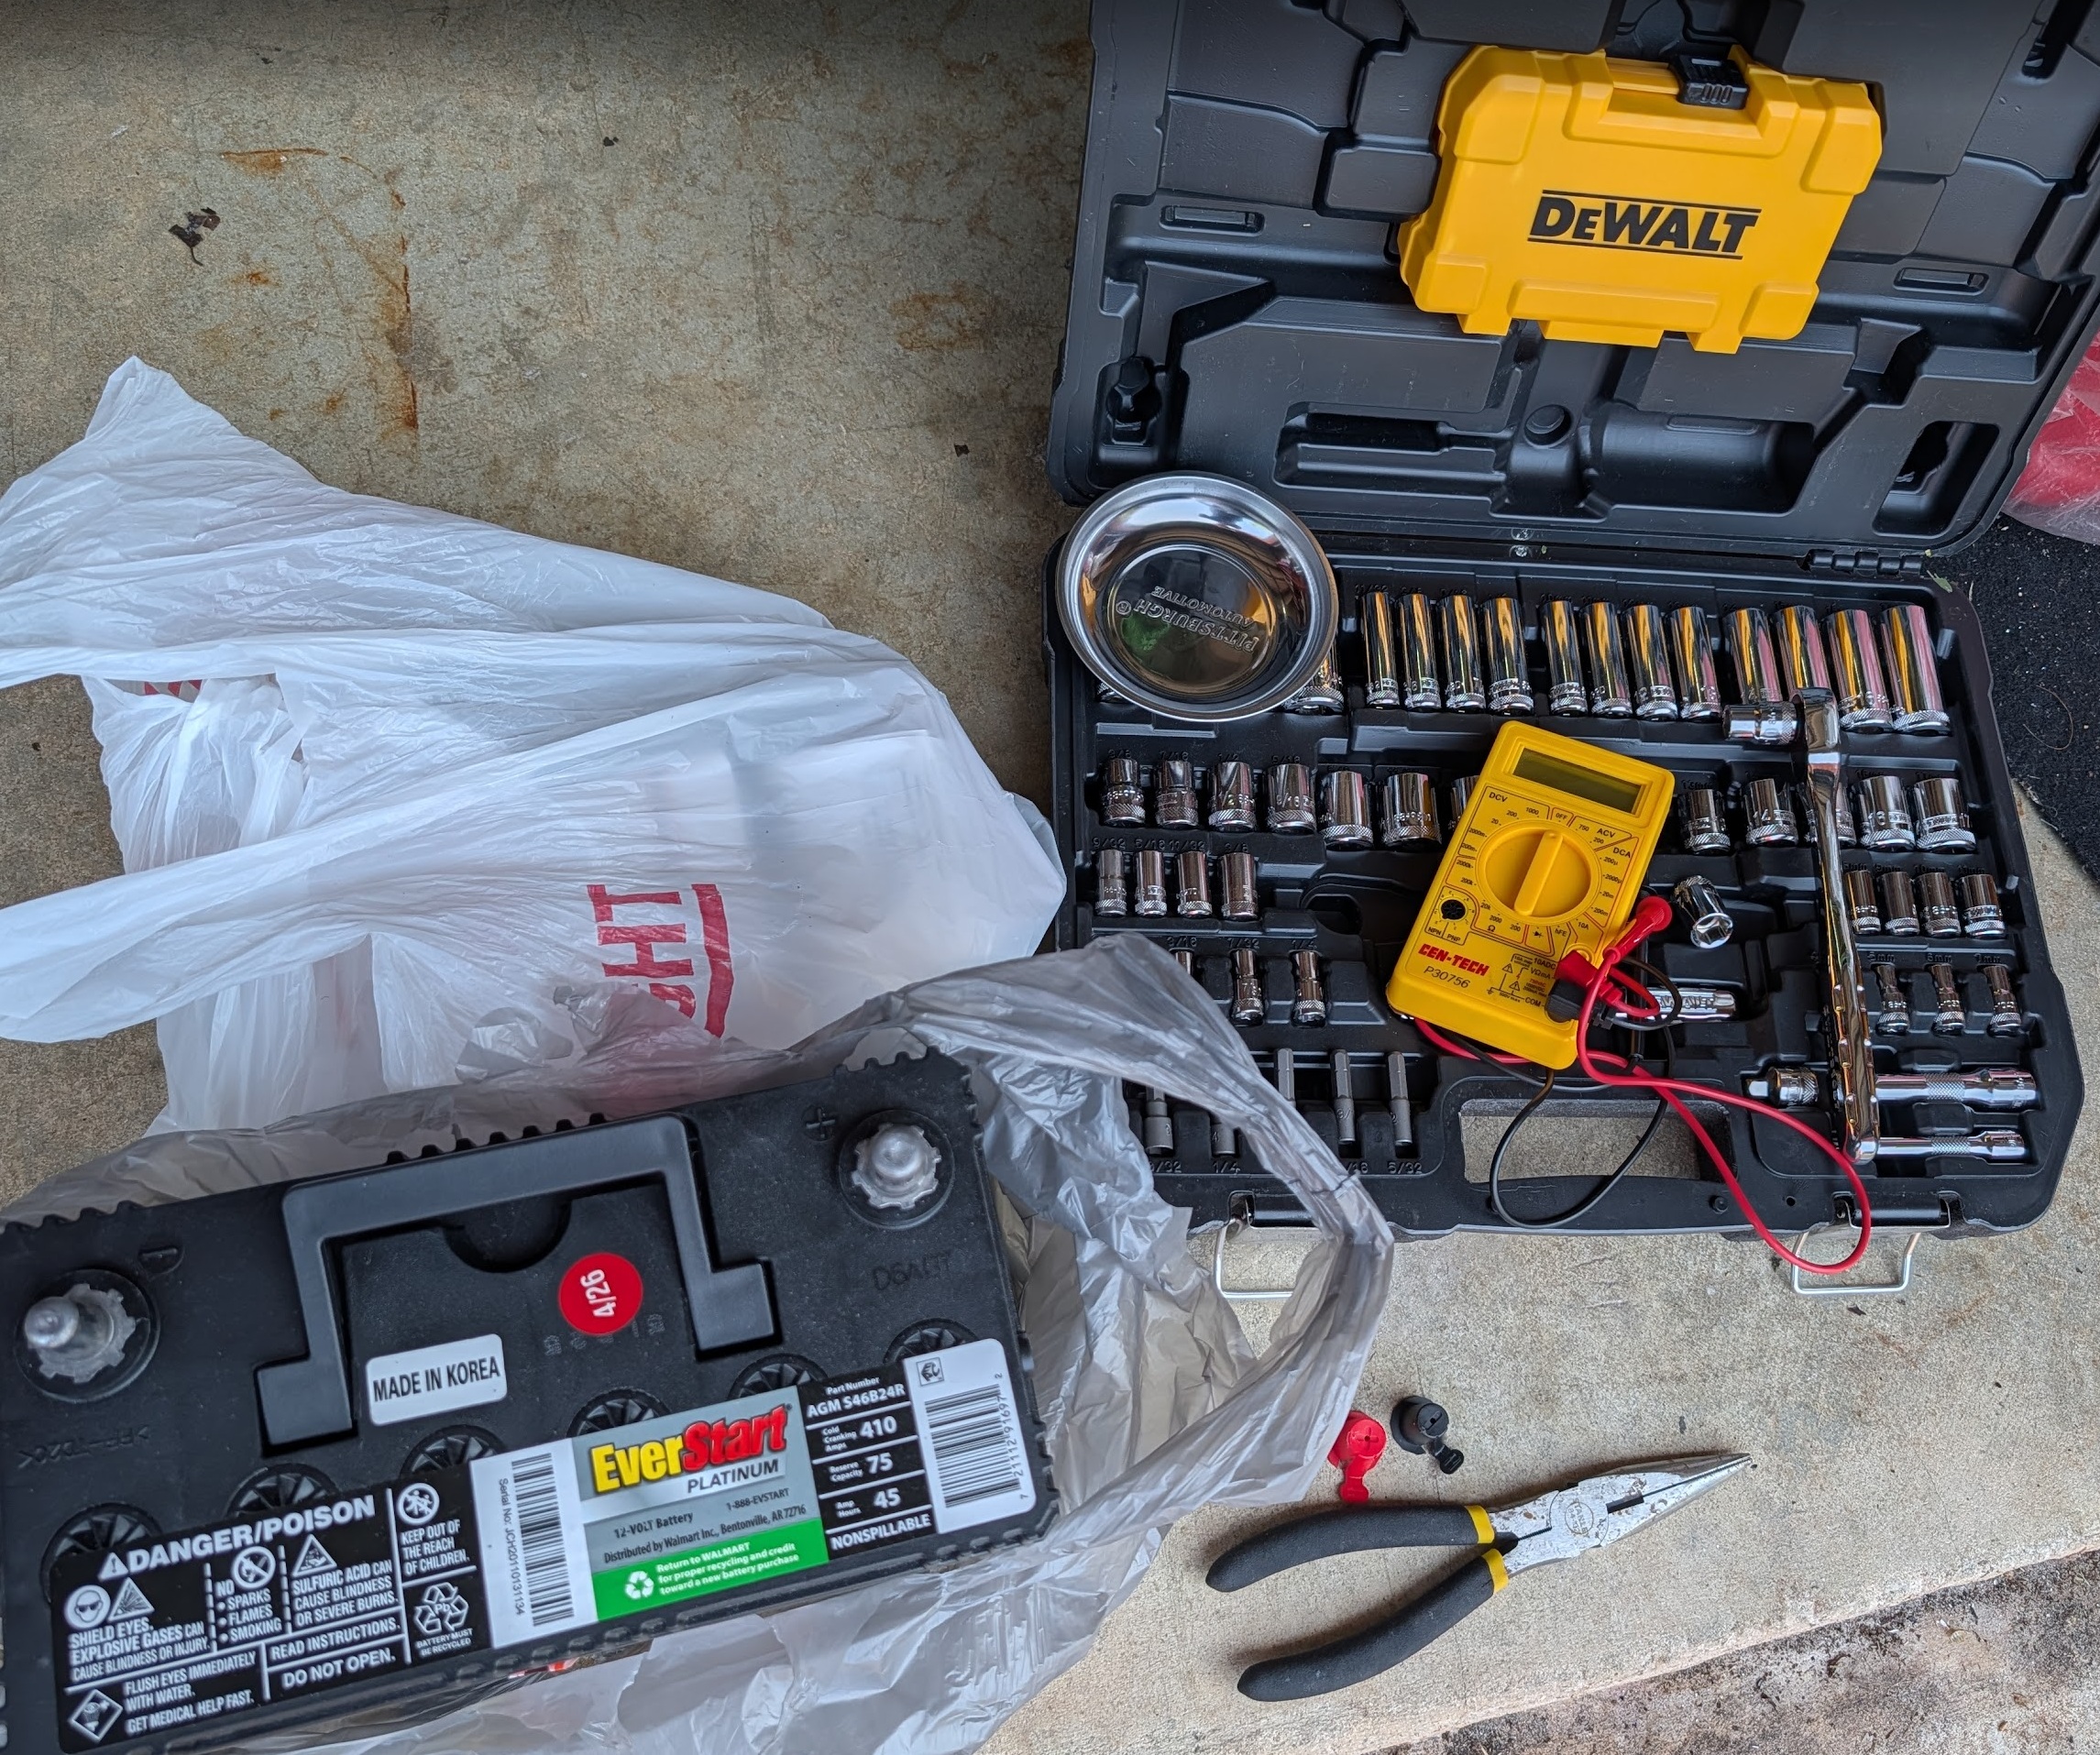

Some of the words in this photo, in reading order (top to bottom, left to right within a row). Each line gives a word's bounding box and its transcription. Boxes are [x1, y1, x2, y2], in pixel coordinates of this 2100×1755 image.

[1150, 585, 1255, 631] AUTOMOTIVE
[1133, 598, 1260, 654] PITTSBURGH
[1489, 792, 1508, 803] DCV
[1556, 812, 1567, 820] OFF
[1597, 828, 1616, 839] ACV
[1612, 847, 1632, 859] DCA
[1418, 943, 1490, 977] CEN-TECH
[1534, 958, 1556, 971] 10ADC
[1424, 965, 1471, 989] P30756
[1525, 997, 1542, 1007] COM
[580, 1269, 617, 1317] 4/26
[373, 1371, 422, 1402] MADE
[425, 1367, 443, 1391] IN
[446, 1356, 501, 1388] KOREA
[826, 1383, 845, 1396] Part
[846, 1377, 880, 1391] Number
[807, 1399, 842, 1419] AGM
[843, 1384, 906, 1409] S46B24R
[822, 1425, 840, 1436] Cold
[823, 1431, 858, 1445] Cranking
[859, 1416, 898, 1440] 410
[589, 1404, 788, 1494] EverStart
[826, 1442, 848, 1453] Amps
[687, 1458, 779, 1493] PLATINUM
[830, 1461, 860, 1474] Reserve
[830, 1468, 863, 1483] Capacity
[865, 1452, 894, 1475] 75
[499, 1477, 510, 1508] Serial
[726, 1488, 789, 1510] 1-888-EVSTART
[835, 1499, 855, 1511] Amp
[873, 1487, 901, 1509] 45
[837, 1506, 862, 1519] Hours
[127, 1495, 376, 1570] DANGER/POISON
[401, 1528, 425, 1545] KEEP
[427, 1524, 446, 1539] OUT
[448, 1519, 461, 1533] OF
[604, 1542, 652, 1564] Distributed
[653, 1540, 664, 1553] by
[664, 1531, 700, 1550] Walmart
[720, 1514, 771, 1535] Bentonville,
[772, 1509, 784, 1522] AR
[784, 1504, 807, 1519] 72716
[614, 1521, 654, 1540] 12-VOLT
[656, 1512, 694, 1529] Battery
[830, 1512, 932, 1551] NONSPILLABLE
[402, 1544, 423, 1561] THE
[423, 1536, 455, 1556] REACH
[656, 1558, 689, 1574] Return
[690, 1555, 701, 1566] to
[701, 1542, 751, 1563] WALMART
[404, 1561, 418, 1576] OF
[420, 1549, 470, 1573] CHILDREN.
[657, 1574, 673, 1585] for
[674, 1565, 706, 1584] proper
[707, 1555, 749, 1575] recycling
[750, 1550, 768, 1564] and
[768, 1542, 797, 1559] credit
[659, 1580, 694, 1596] toward
[701, 1573, 721, 1585] new
[721, 1562, 756, 1580] battery
[756, 1552, 799, 1573] purchase
[214, 1579, 235, 1597] NO
[291, 1570, 344, 1596] SULFURIC
[346, 1562, 371, 1582] ACID
[374, 1559, 392, 1575] CAN
[228, 1588, 271, 1611] SPARKS
[293, 1590, 330, 1612] CAUSE
[333, 1576, 392, 1601] BLINDNESS
[229, 1604, 273, 1627] FLAMES
[295, 1611, 313, 1627] OR
[315, 1601, 356, 1623] SEVERE
[357, 1590, 400, 1611] BURNS.
[434, 1603, 450, 1616] Pb
[69, 1625, 115, 1650] SHIELD
[116, 1617, 154, 1635] EYES.
[71, 1636, 140, 1666] EXPLOSIVE
[142, 1624, 183, 1649] GASES
[184, 1620, 204, 1639] CAN
[230, 1618, 282, 1643] SMOKING
[271, 1643, 305, 1662] READ
[307, 1617, 401, 1652] INSTRUCTIONS.
[415, 1633, 450, 1649] BATTERY
[451, 1628, 473, 1641] MUST
[72, 1662, 104, 1683] CAUSE
[105, 1649, 158, 1673] BLINDNESS
[159, 1646, 174, 1660] OR
[175, 1636, 211, 1656] INJURY.
[420, 1646, 434, 1657] BE
[434, 1637, 472, 1655] RECYCLED
[125, 1675, 159, 1696] FLUSH
[160, 1668, 187, 1687] EYES
[189, 1651, 257, 1680] IMMEDIATELY
[282, 1669, 307, 1690] DO
[311, 1658, 344, 1682] NOT
[346, 1647, 396, 1673] OPEN.
[125, 1693, 154, 1714] WITH
[155, 1684, 196, 1704] WATER.
[126, 1715, 148, 1735] GET
[149, 1705, 196, 1727] MEDICAL
[197, 1695, 225, 1715] HELP
[226, 1689, 255, 1708] FAST.
